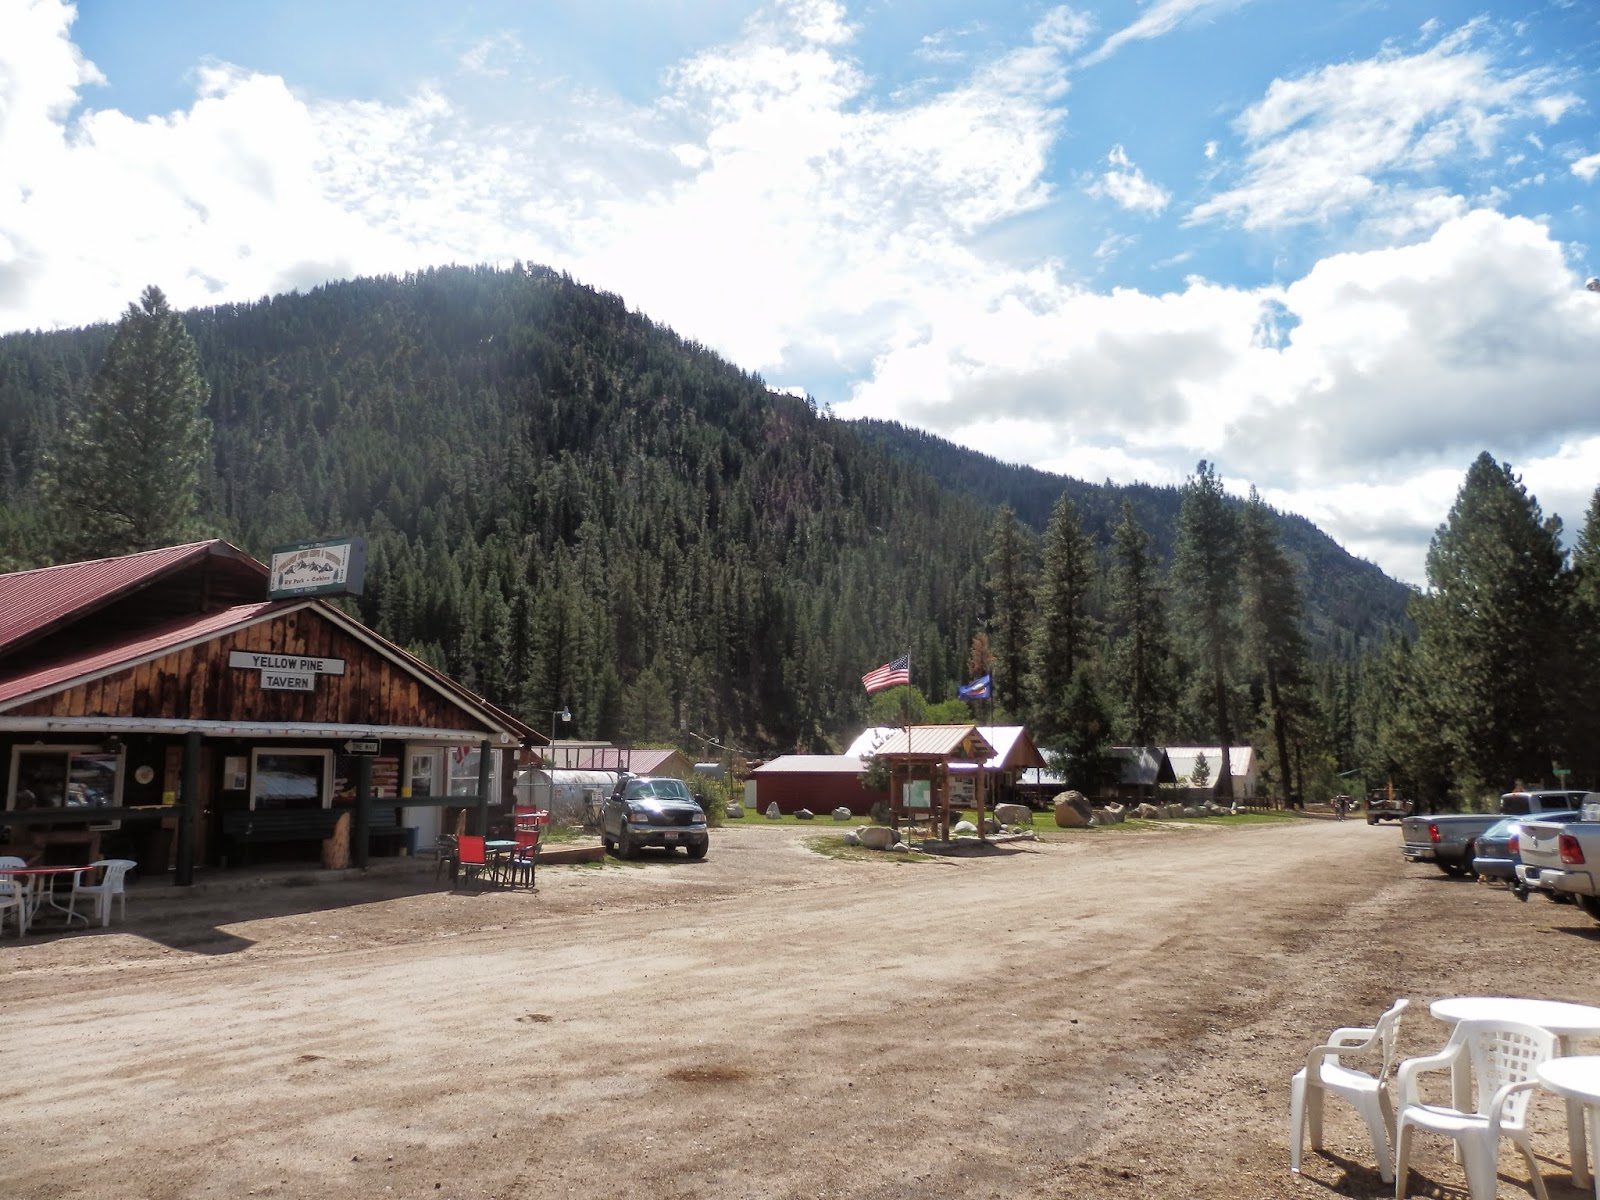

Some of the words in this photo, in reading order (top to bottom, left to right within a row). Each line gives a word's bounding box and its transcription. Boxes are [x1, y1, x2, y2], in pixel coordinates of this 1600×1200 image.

[252, 656, 297, 669] YELLOW
[300, 659, 323, 671] PINE
[266, 676, 309, 688] TAVERN
